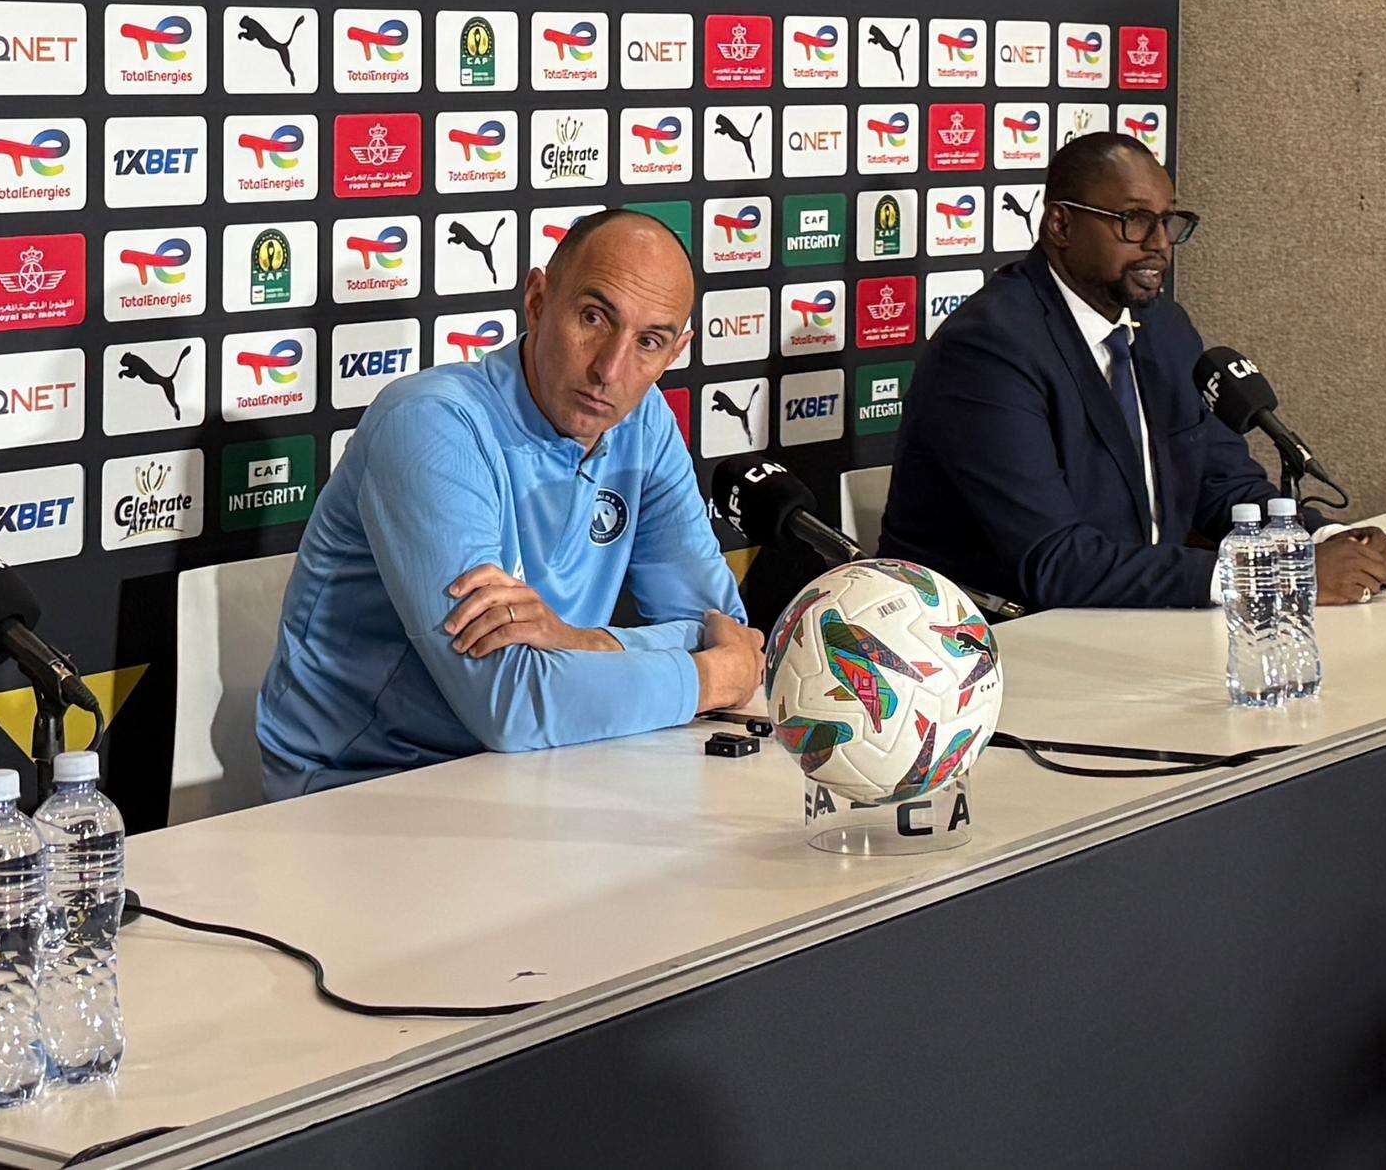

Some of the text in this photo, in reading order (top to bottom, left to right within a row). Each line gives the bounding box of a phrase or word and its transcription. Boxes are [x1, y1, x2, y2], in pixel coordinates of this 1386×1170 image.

[628, 41, 687, 62] QNET
[1000, 45, 1046, 64] QNET
[121, 70, 192, 84] TotalEnergies
[347, 70, 409, 83] TotalEnergies
[789, 131, 841, 151] QNET
[114, 148, 198, 175] 1XBET
[541, 143, 599, 170] Celebrate
[238, 177, 304, 191] TotalEnergies
[804, 215, 826, 225] CAF
[787, 234, 841, 251] INTEGRITY
[258, 272, 283, 281] CAF
[347, 277, 408, 290] TotalEnergies
[120, 293, 191, 308] TotalEnergies
[931, 294, 968, 317] 1XB
[709, 314, 765, 338] QNET
[339, 348, 412, 379] 1XBET
[236, 391, 303, 409] TotalEnergies
[786, 394, 838, 421] 1XBET
[859, 400, 903, 420] INTEGRIT
[253, 464, 285, 478] CAF
[228, 486, 307, 512] INTEGRITY
[115, 493, 192, 527] Celebrate
[125, 514, 175, 536] Africa
